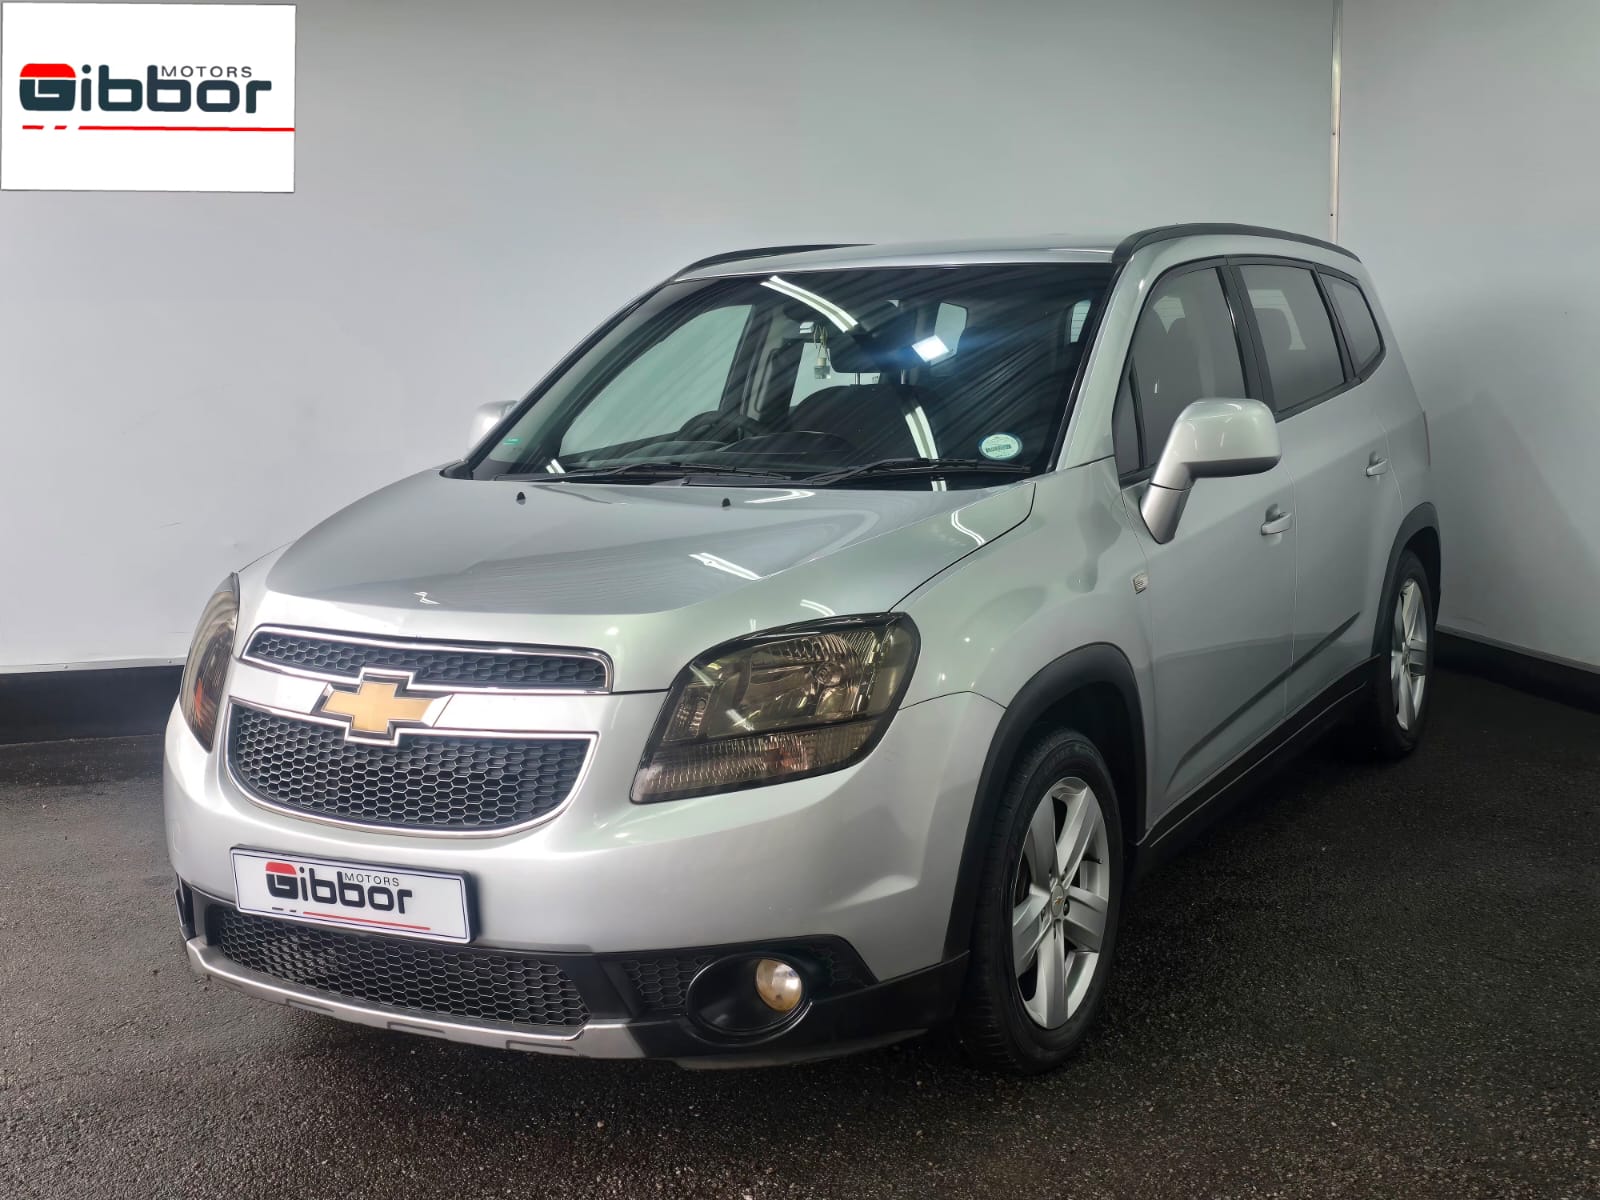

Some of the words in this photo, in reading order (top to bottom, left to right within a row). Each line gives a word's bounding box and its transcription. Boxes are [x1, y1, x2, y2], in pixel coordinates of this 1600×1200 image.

[161, 65, 252, 77] MOTORS
[19, 63, 272, 113] Gibbor
[265, 861, 412, 914] Gibbor
[344, 872, 400, 887] MOTORS
